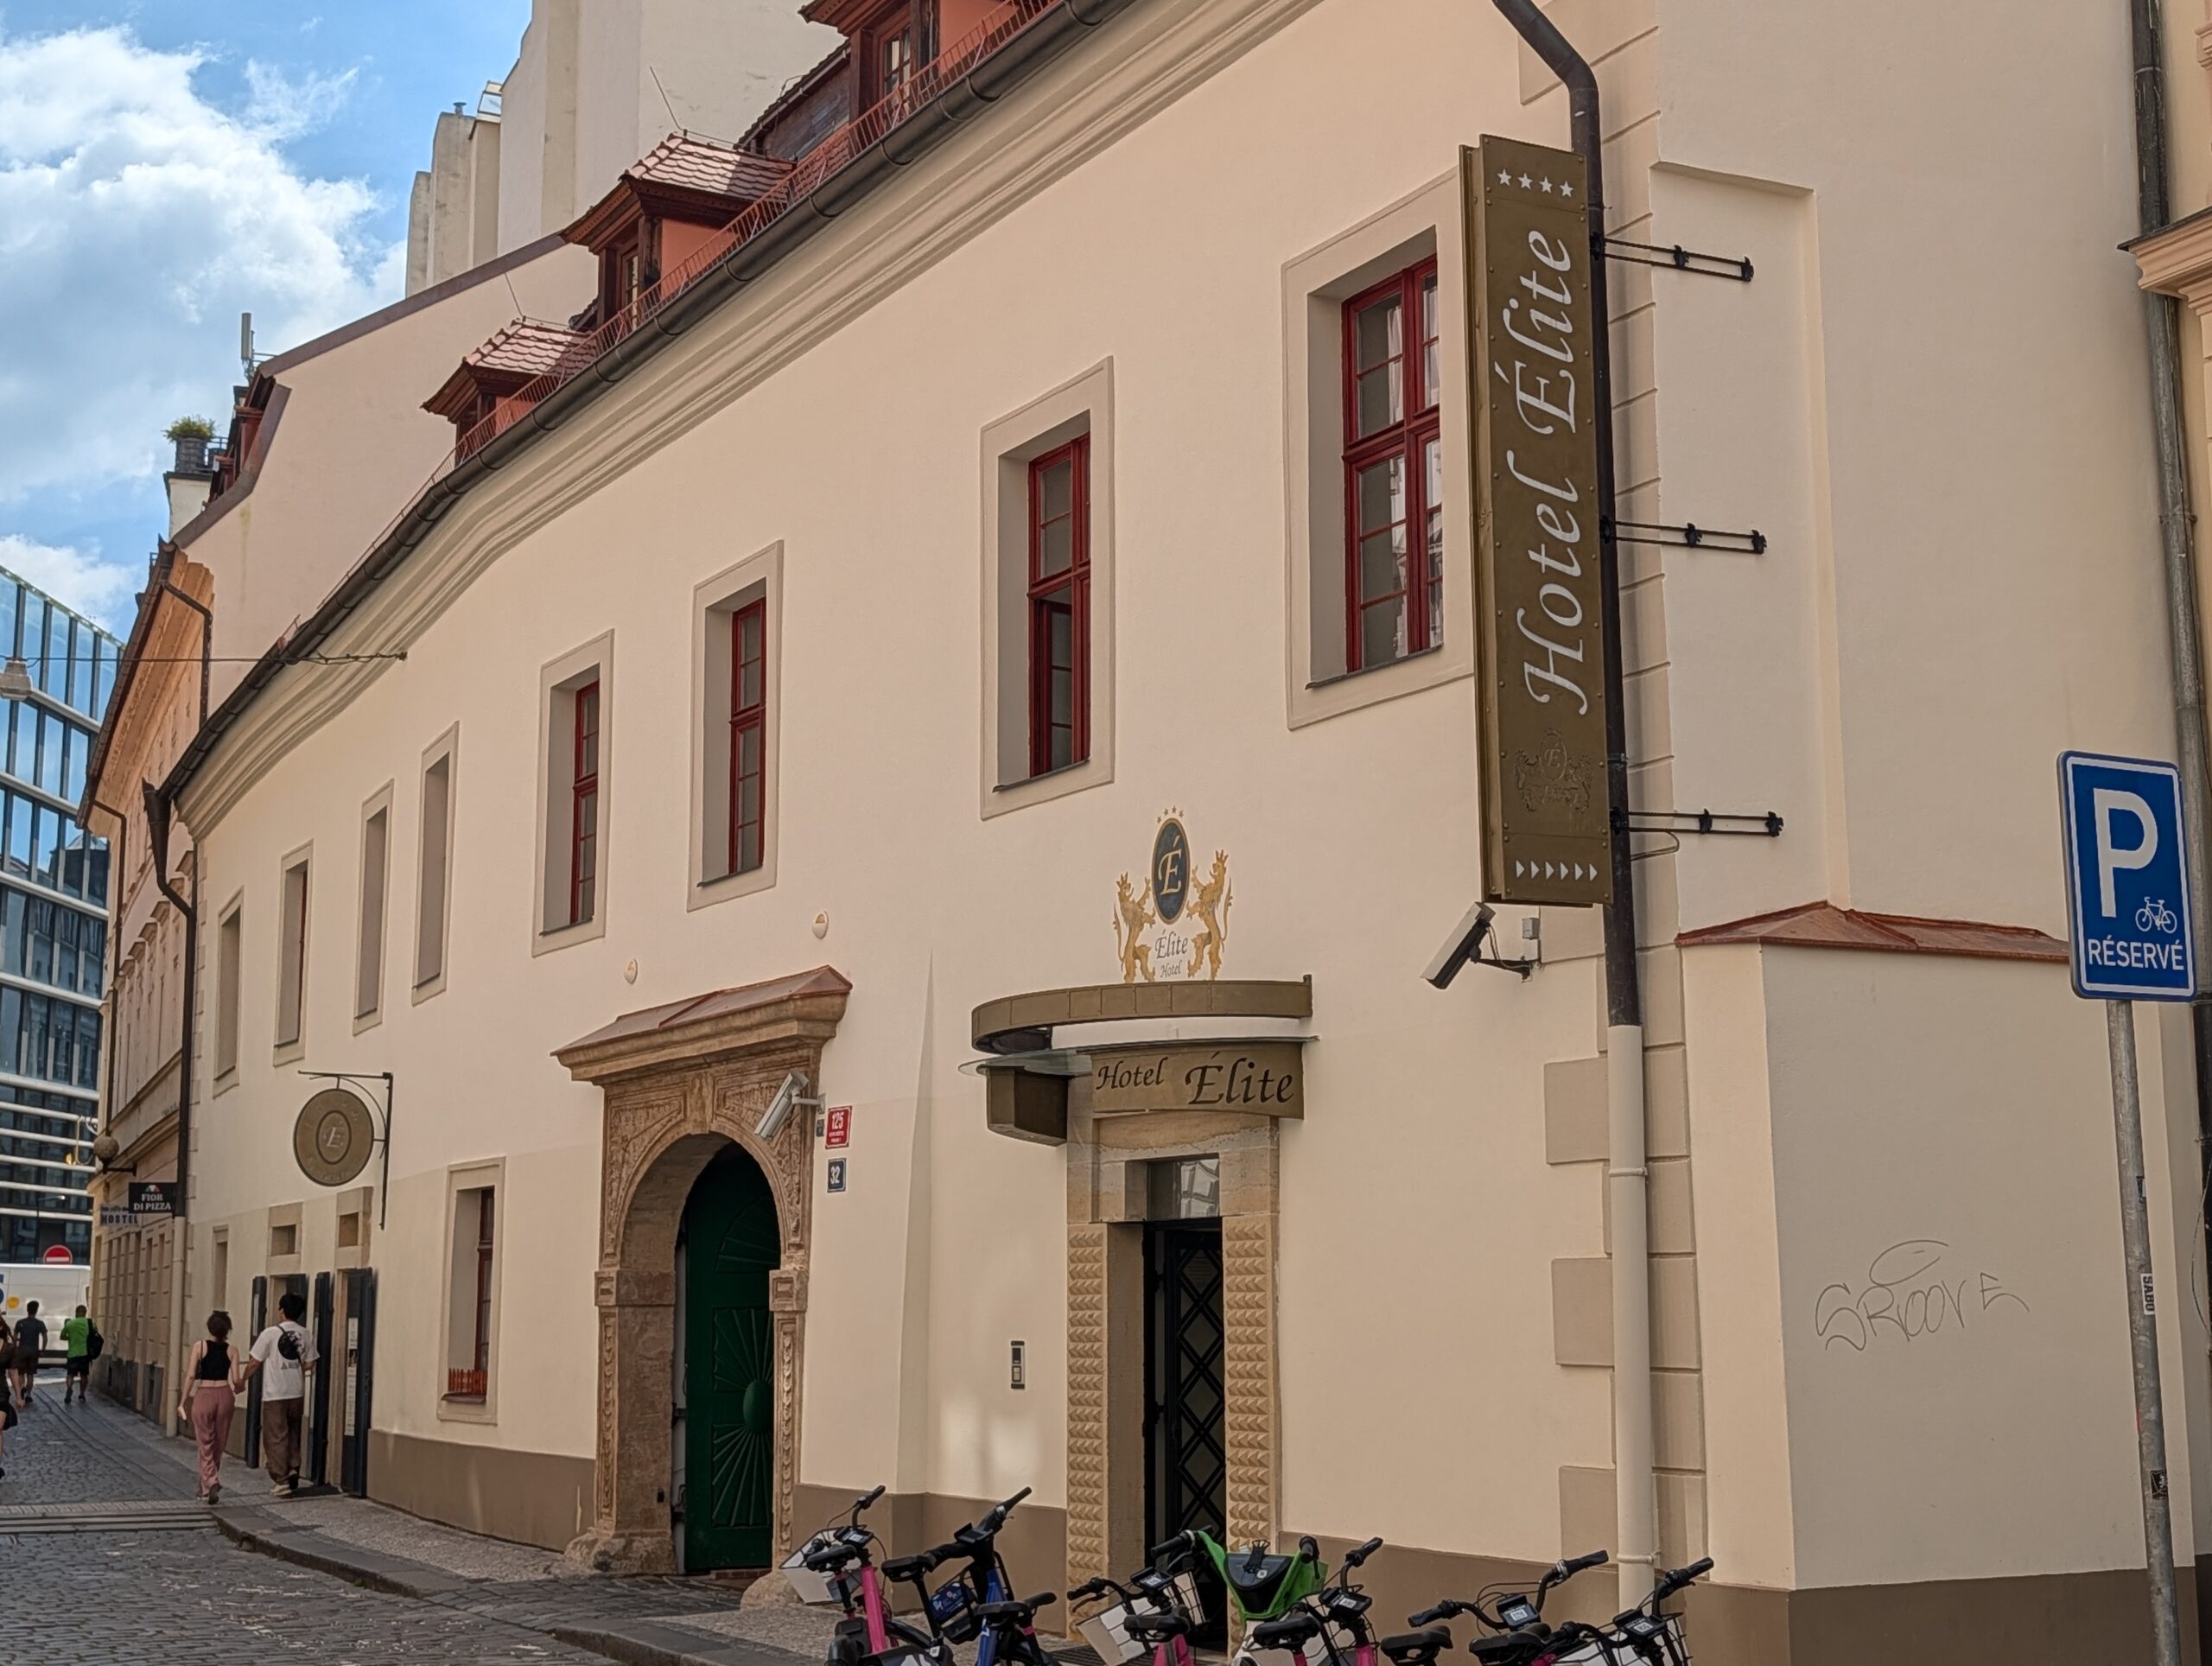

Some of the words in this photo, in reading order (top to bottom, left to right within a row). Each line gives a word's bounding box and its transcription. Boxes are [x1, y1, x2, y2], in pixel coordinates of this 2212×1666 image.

[1493, 229, 1577, 434] Élite
[1507, 449, 1587, 715] Hotel
[2093, 787, 2158, 919] P
[1154, 929, 1188, 960] Élite
[2088, 934, 2185, 971] RÉSERVÉ
[1160, 959, 1183, 979] Hotel
[1096, 1057, 1168, 1091] Hotel
[1185, 1052, 1294, 1105] Élite
[831, 1111, 844, 1129] 125
[830, 1166, 841, 1185] 32
[141, 1193, 163, 1202] FIOR
[145, 1202, 172, 1211] PIZZA
[101, 1214, 139, 1224] HOSTEL
